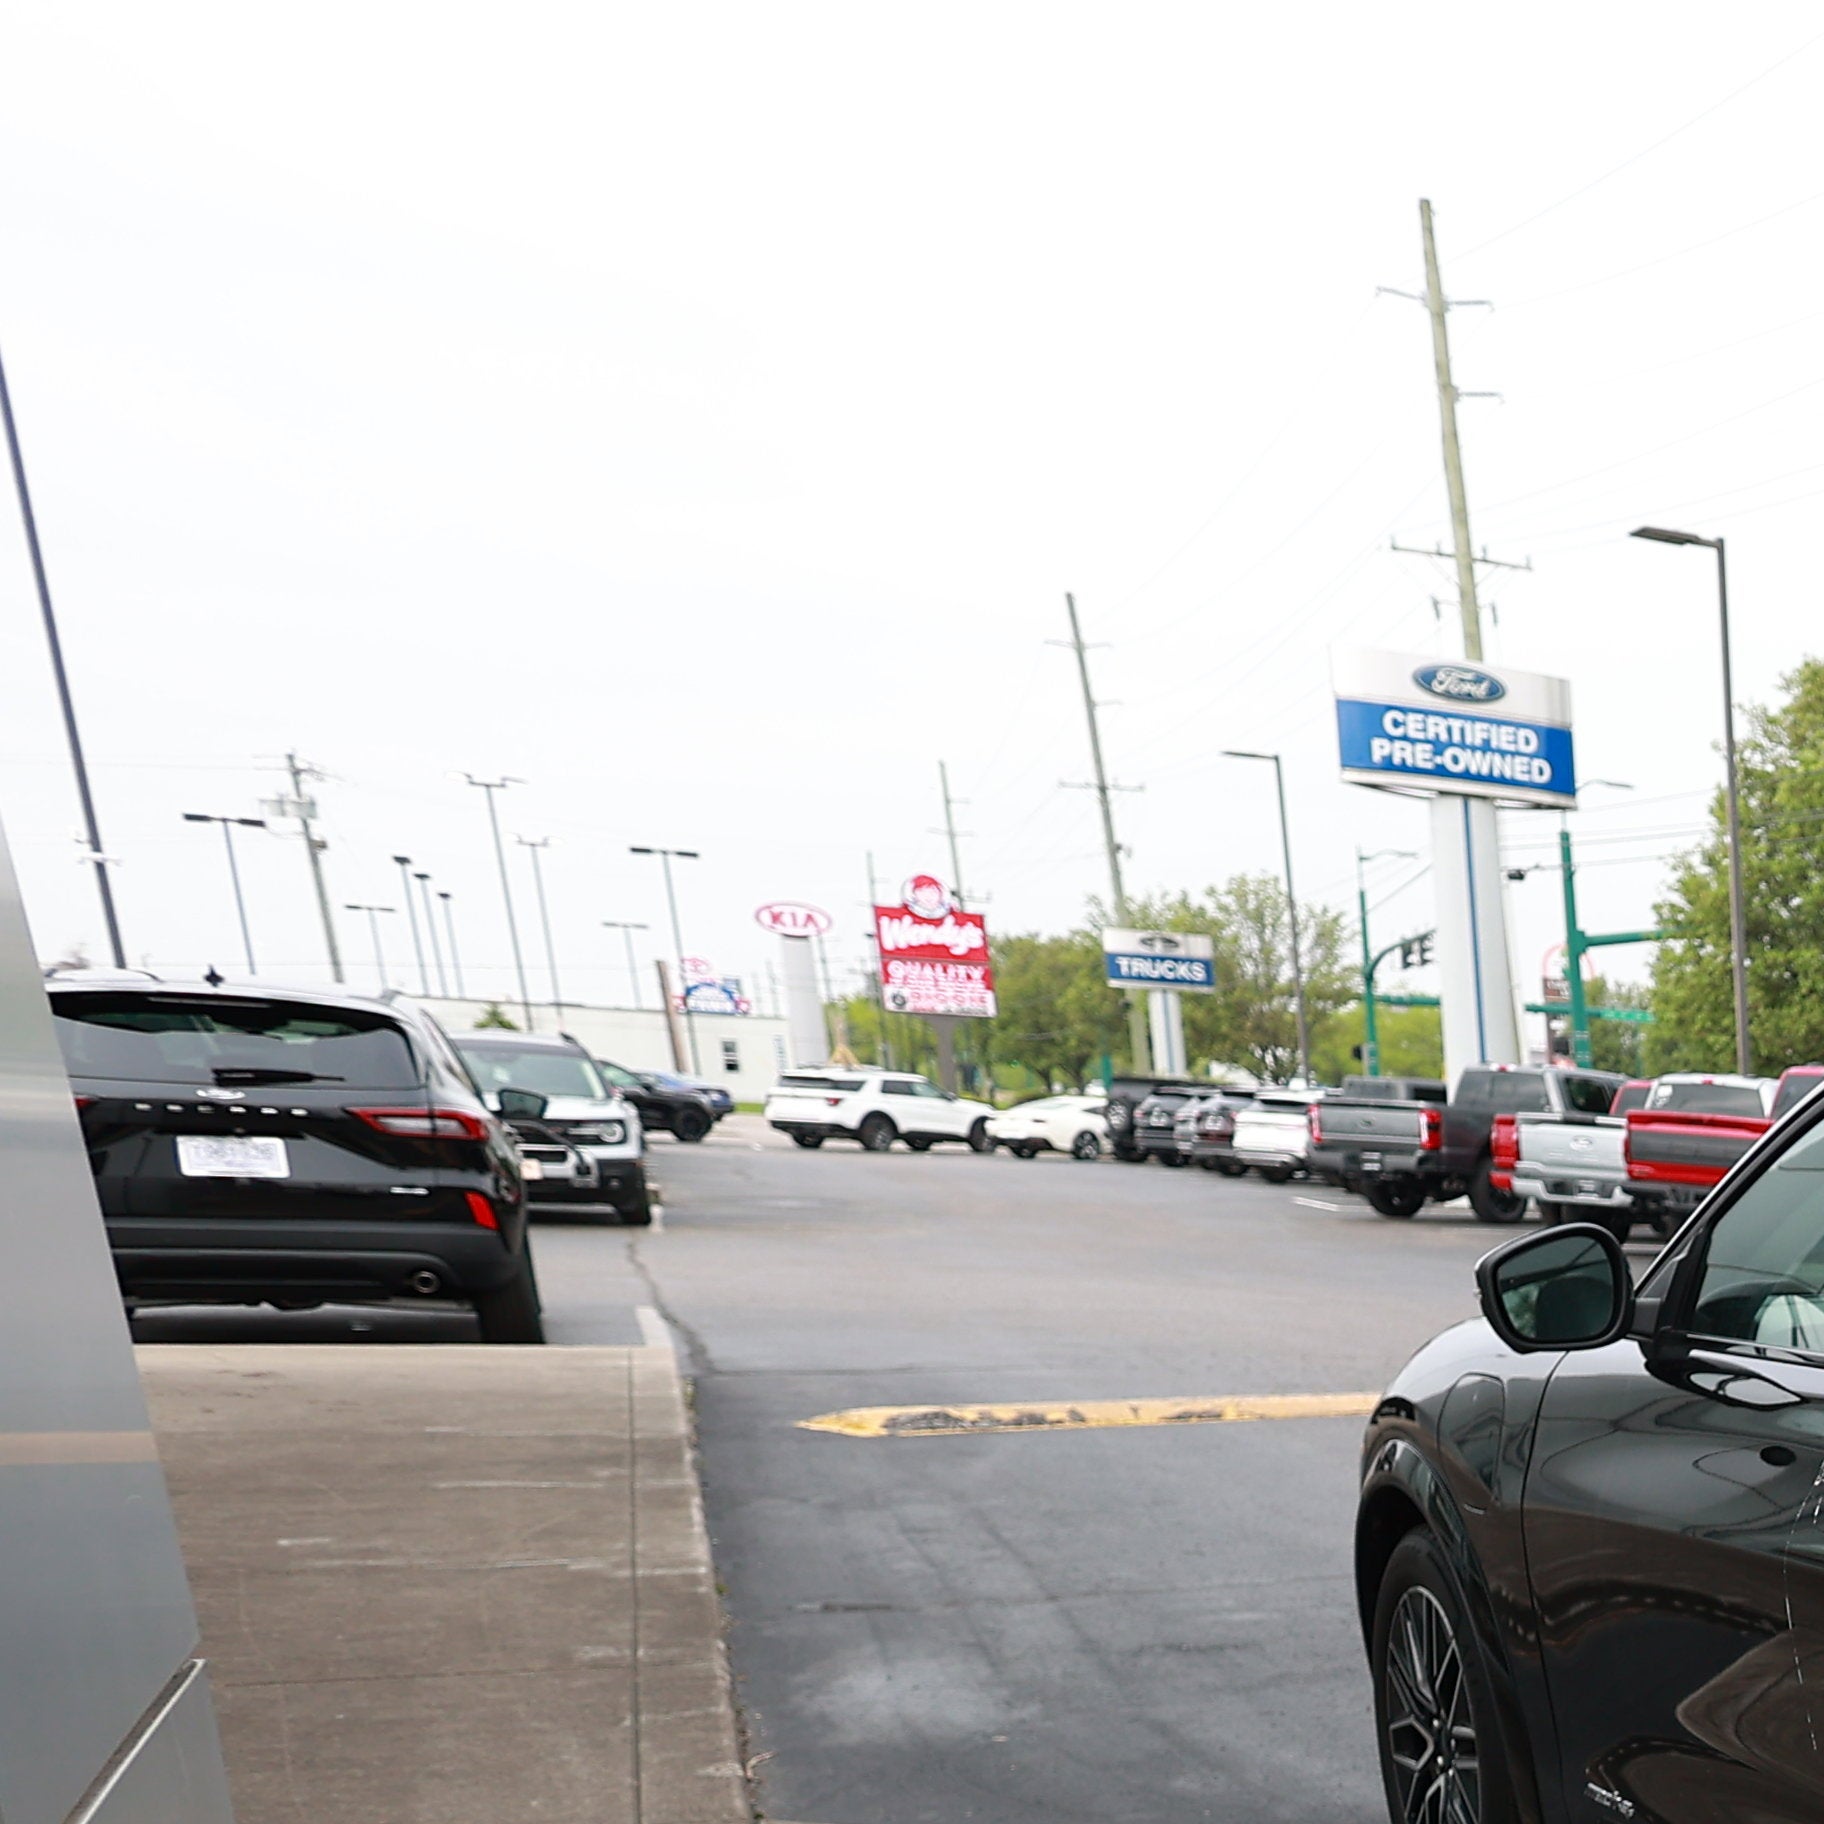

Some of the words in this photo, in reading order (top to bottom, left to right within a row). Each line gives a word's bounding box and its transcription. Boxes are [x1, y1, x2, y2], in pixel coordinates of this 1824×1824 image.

[1431, 667, 1491, 698] Ford
[1382, 709, 1539, 754] CERTIFIED
[1370, 737, 1552, 784] PRE-OWNED
[769, 911, 819, 929] KIA
[880, 914, 984, 956] Wendy's
[887, 960, 985, 981] QUALITY
[1115, 956, 1207, 981] TRUCKS
